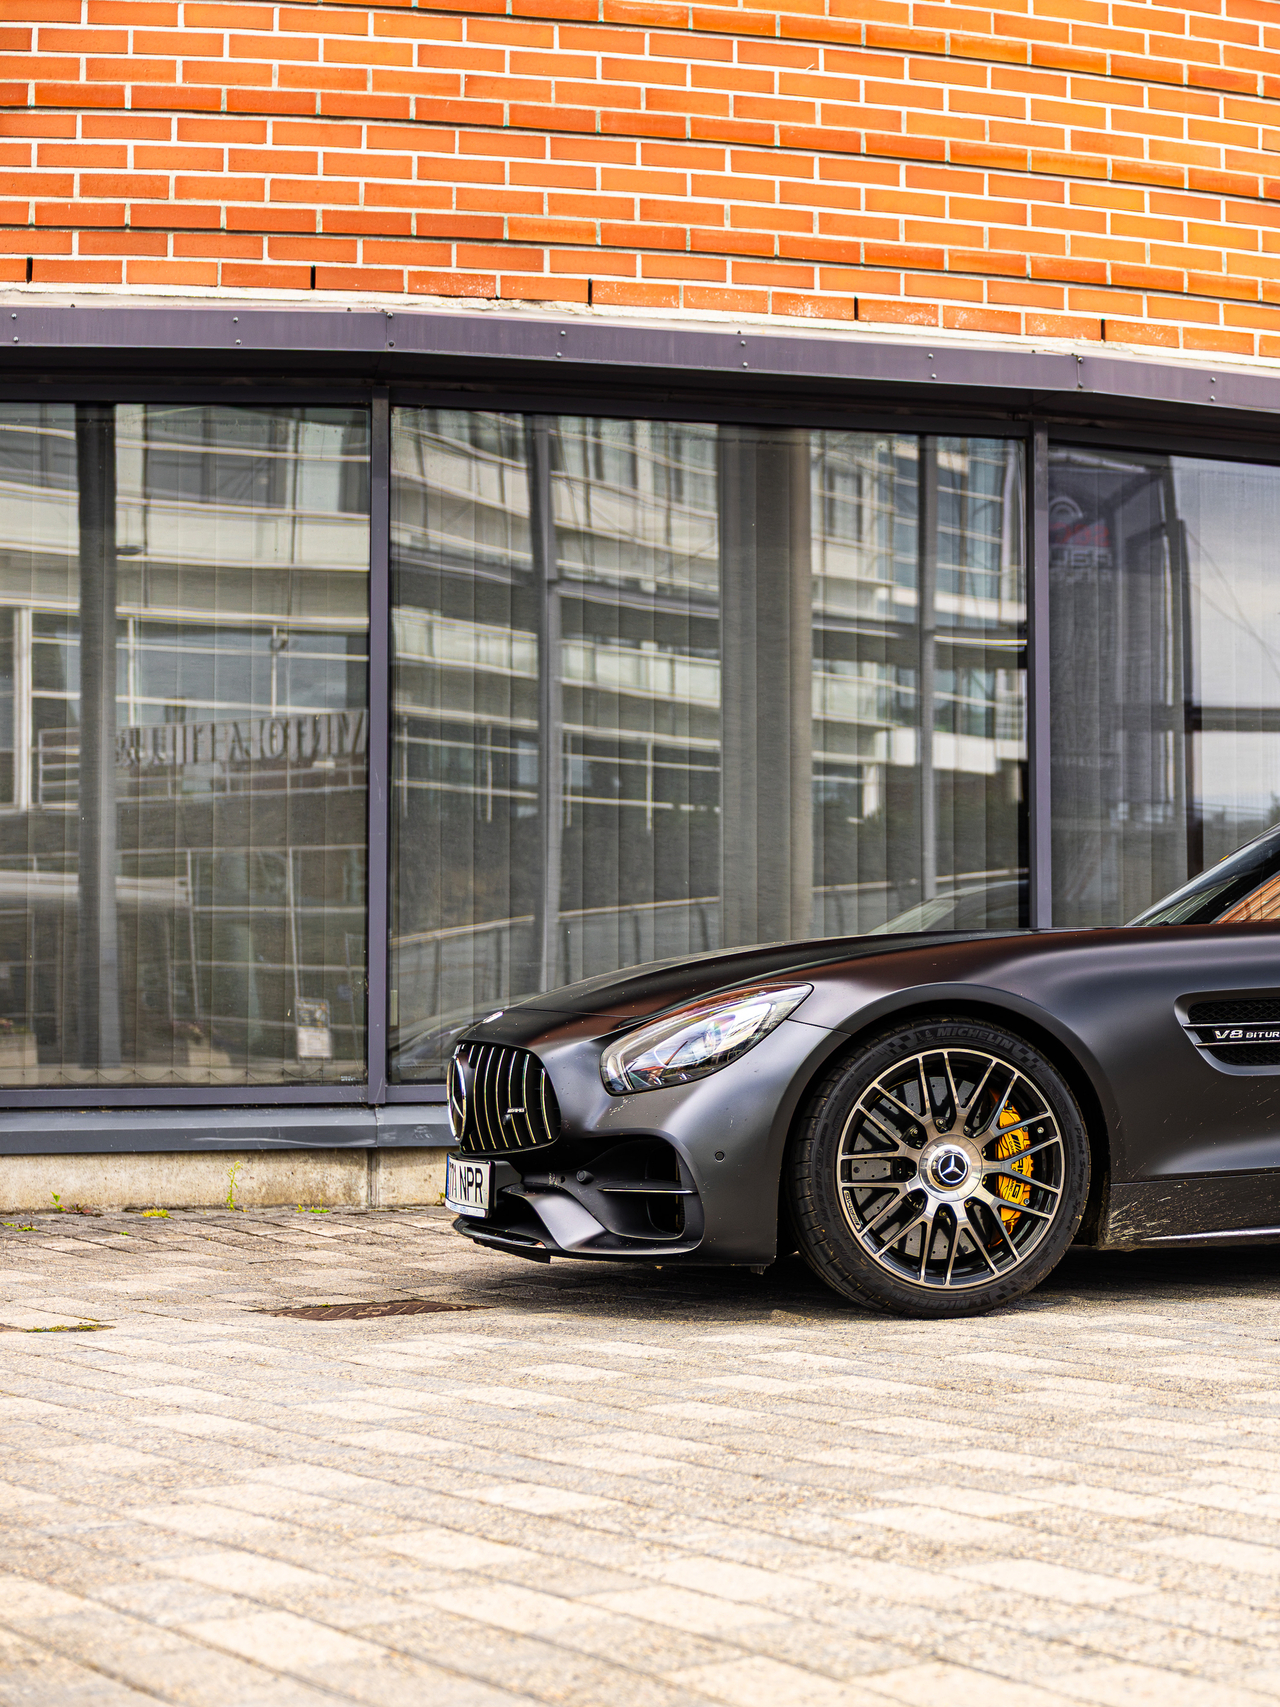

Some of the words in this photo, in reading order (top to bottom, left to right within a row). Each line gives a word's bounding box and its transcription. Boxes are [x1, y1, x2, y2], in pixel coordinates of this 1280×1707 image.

[936, 1027, 1014, 1049] MICHELIN
[1214, 1030, 1243, 1039] V8
[1074, 1127, 1085, 1155] Pilot
[459, 1165, 483, 1204] NPR
[1078, 1160, 1086, 1194] Super
[1066, 1200, 1081, 1232] Sport
[891, 1287, 971, 1310] MICHELIN
